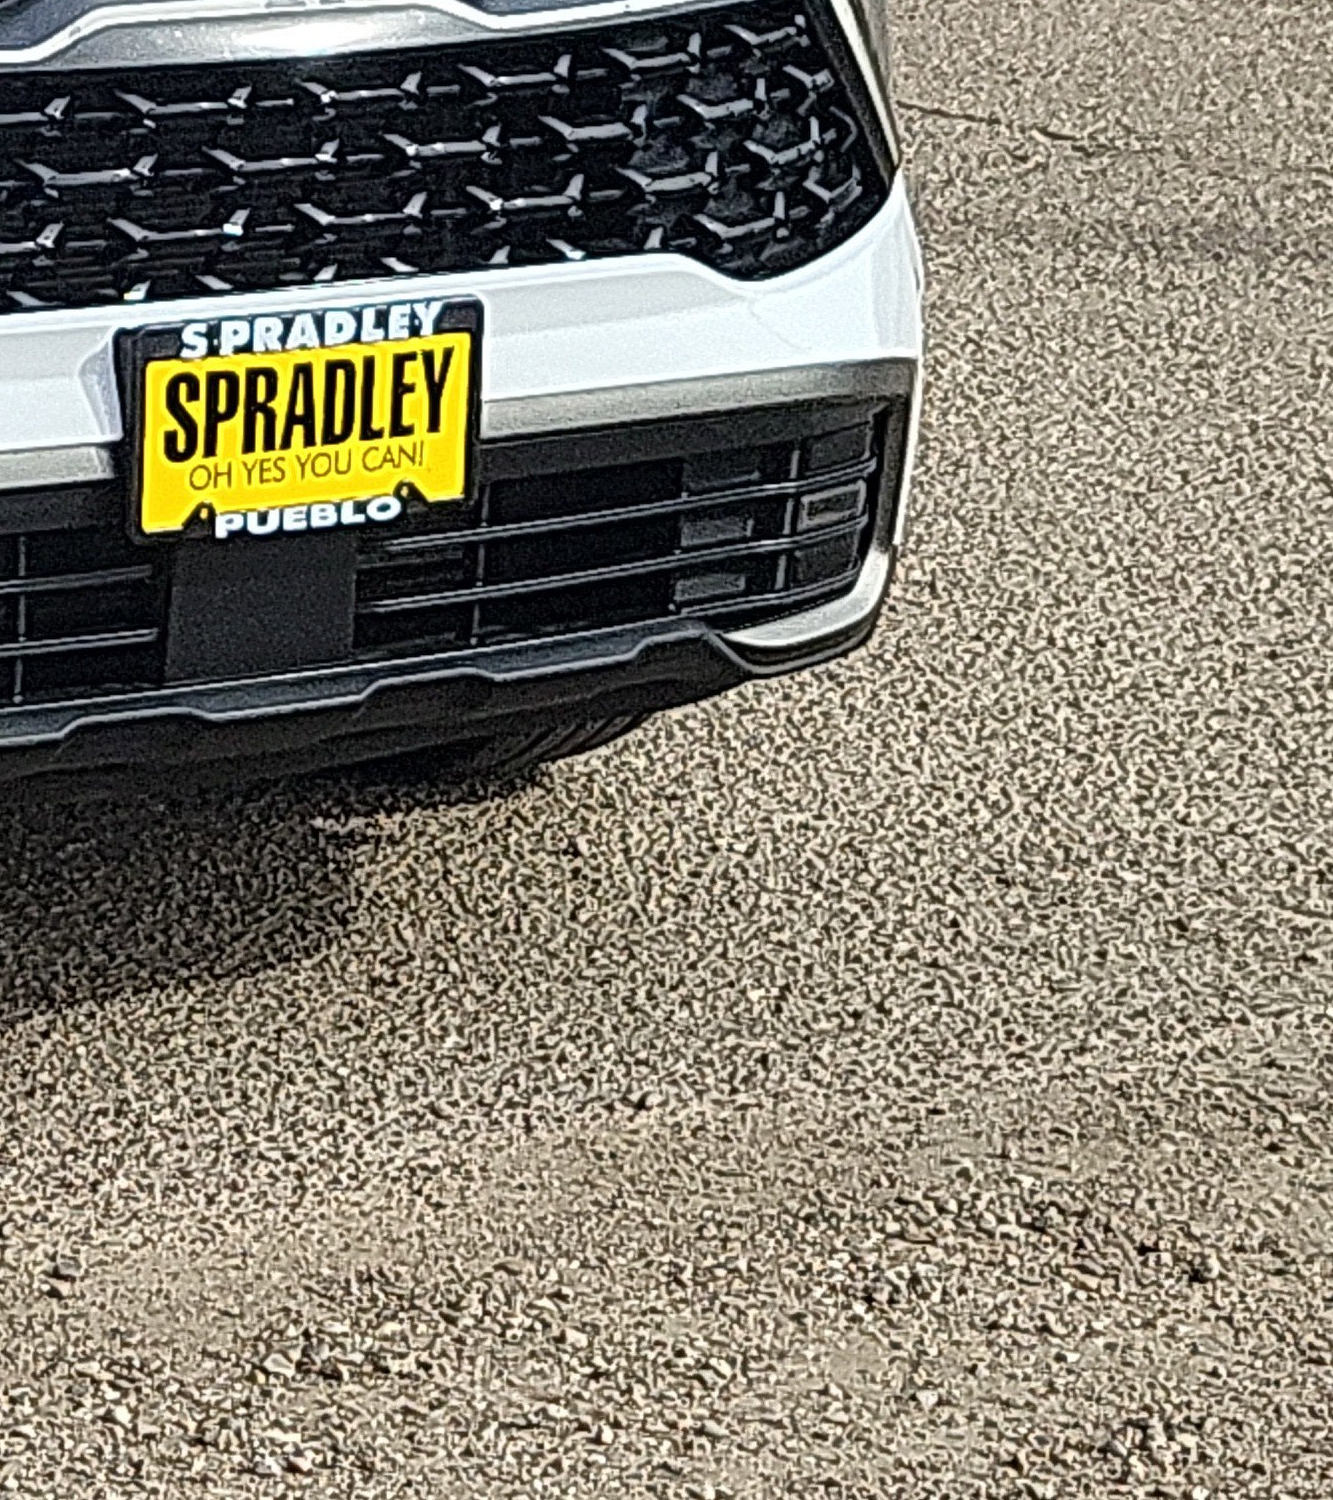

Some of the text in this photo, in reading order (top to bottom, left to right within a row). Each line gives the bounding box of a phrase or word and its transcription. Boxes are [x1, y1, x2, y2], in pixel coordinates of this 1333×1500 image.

[164, 345, 455, 464] SPRADLEY
[189, 440, 424, 490] OH YES YOU CAN!
[215, 495, 402, 540] PUEBLO
